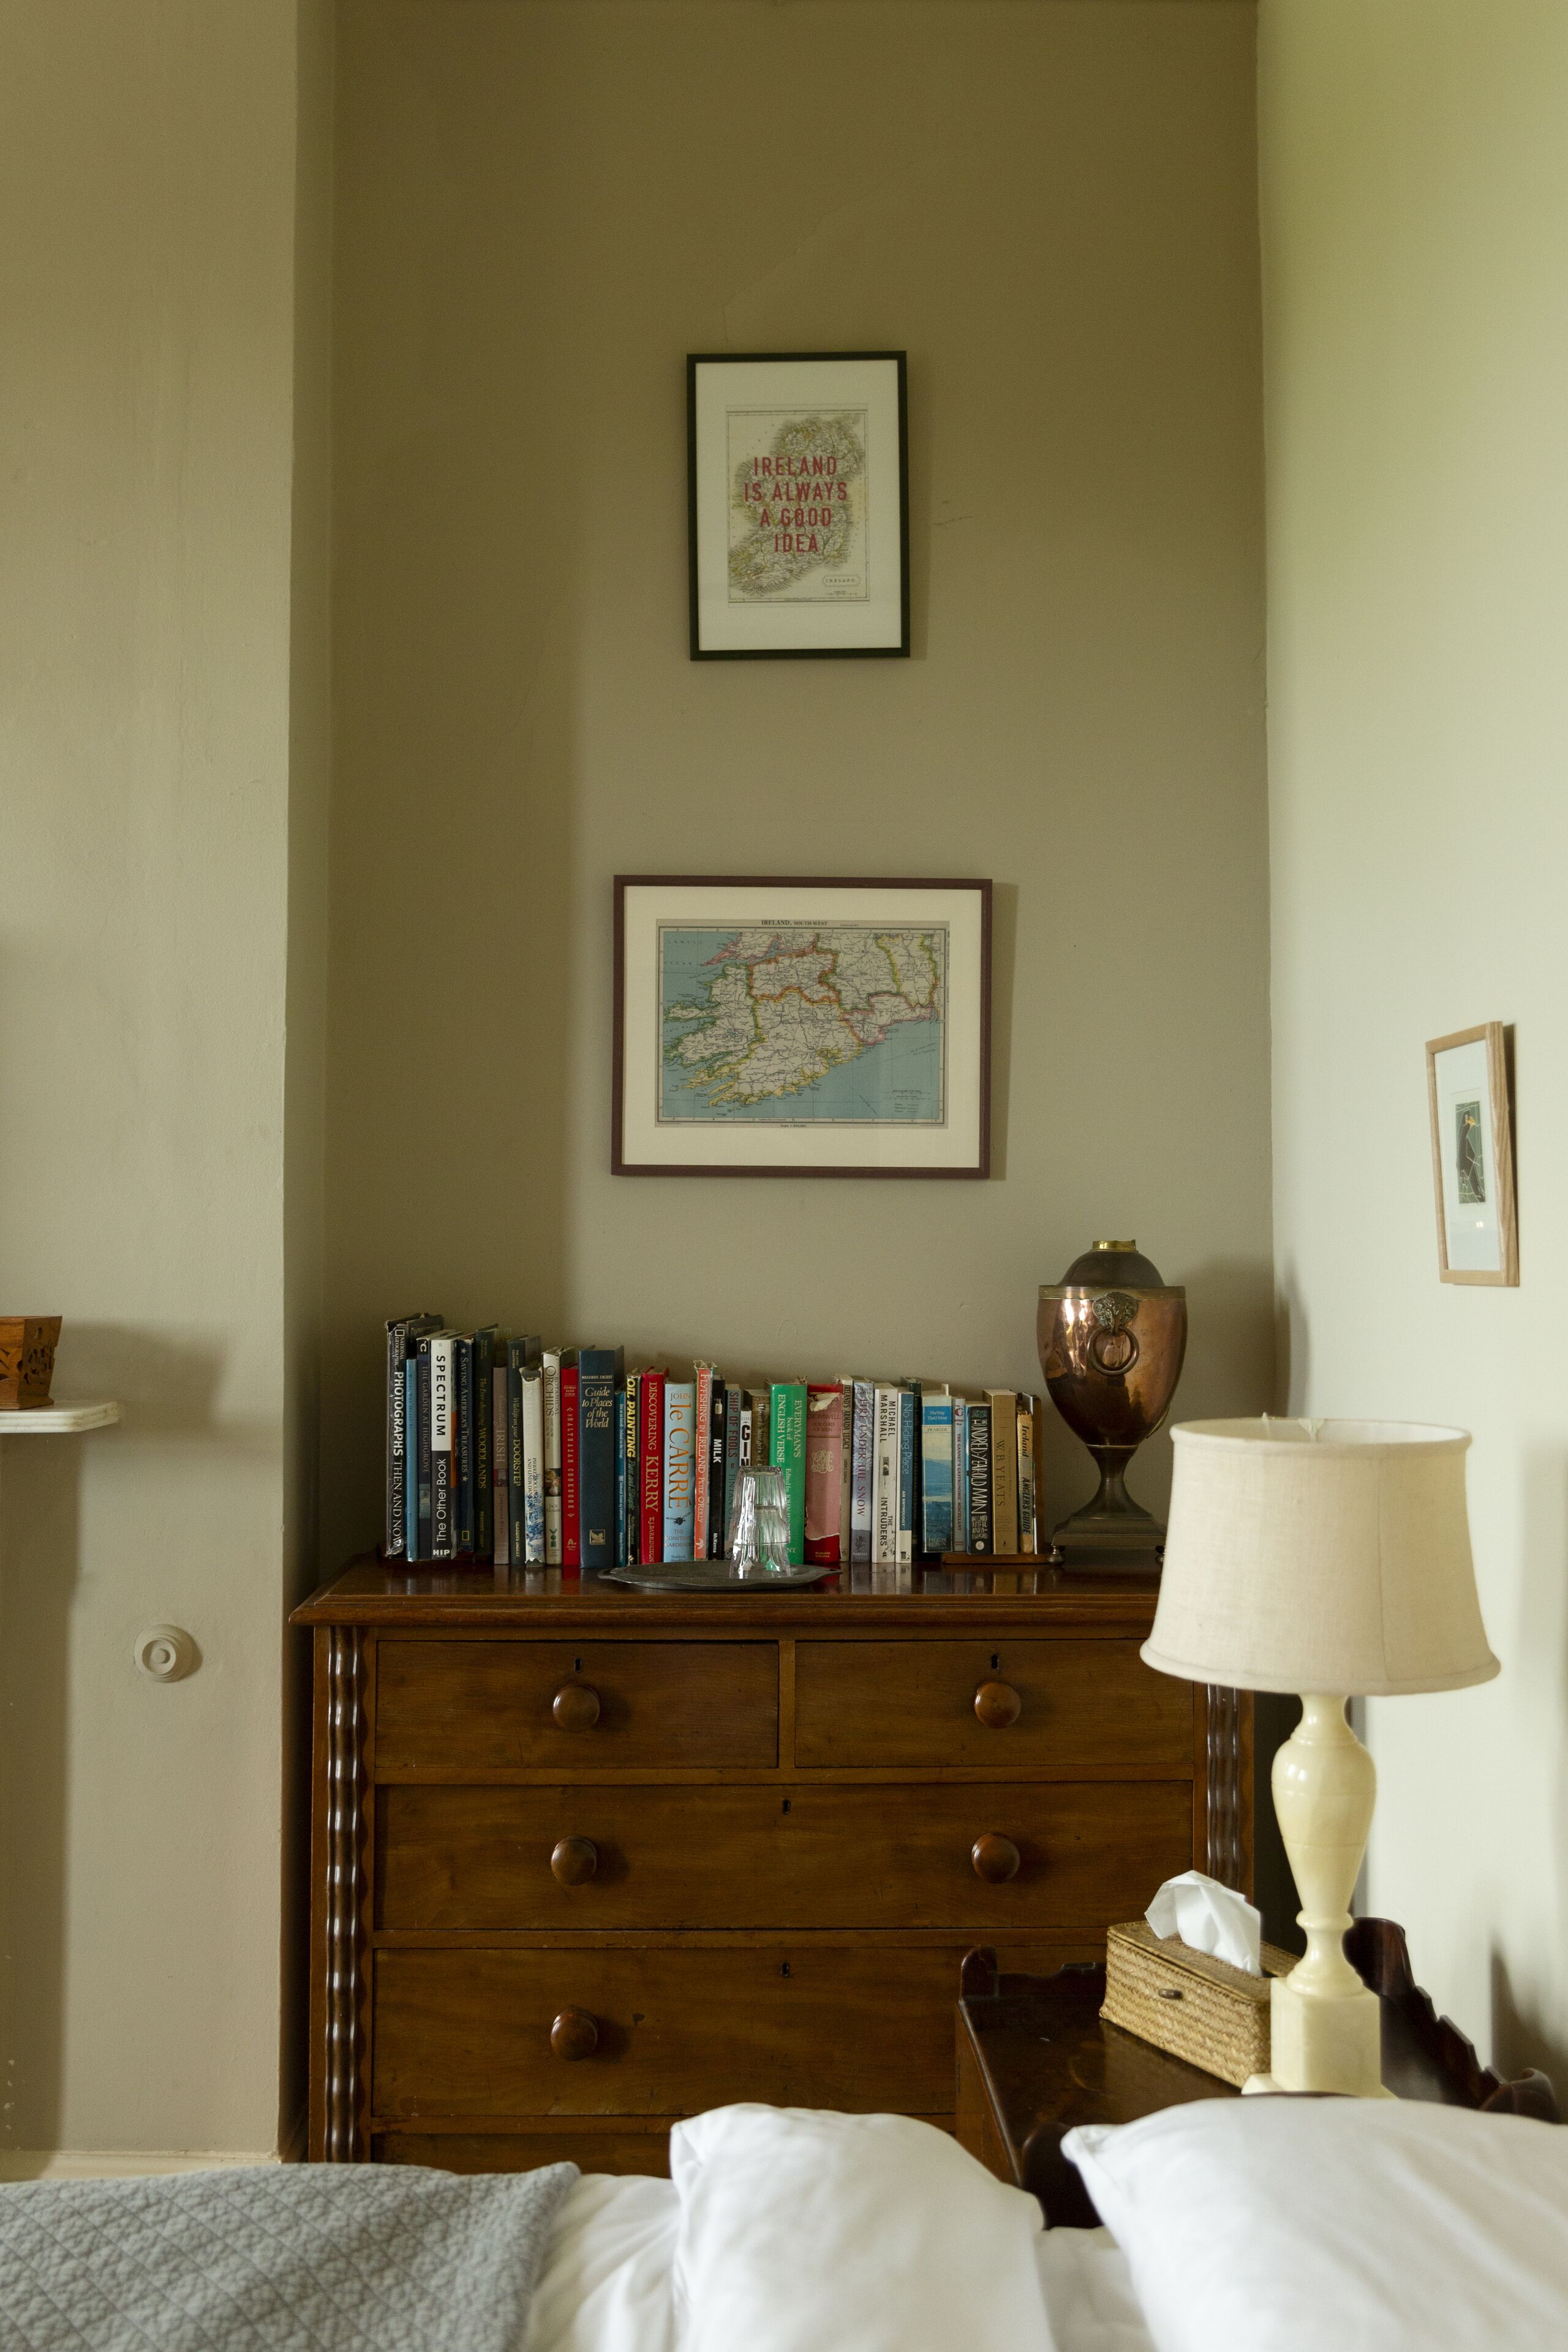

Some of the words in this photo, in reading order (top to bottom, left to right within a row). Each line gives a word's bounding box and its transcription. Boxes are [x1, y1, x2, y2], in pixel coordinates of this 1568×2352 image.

[753, 455, 838, 477] IRELAND
[744, 483, 763, 502] IS
[771, 481, 848, 502] ALWAYS
[759, 508, 771, 528] A
[780, 508, 832, 528] GOOD
[774, 533, 819, 553] IDEA
[460, 1357, 469, 1385] SAVING
[436, 1355, 446, 1436] SPECTRUM
[545, 1366, 556, 1416] ORCHIDS
[584, 1386, 610, 1397] Guide
[626, 1379, 636, 1398] OIL
[699, 1373, 710, 1422] FLYFISHING
[843, 1385, 852, 1408] IRELAND'S
[393, 1371, 404, 1457] PHOTOGRAPHS
[461, 1388, 470, 1428] AMERICA'S
[587, 1408, 597, 1419] of
[596, 1407, 608, 1417] the
[589, 1397, 613, 1408] Places
[669, 1403, 692, 1421] le
[728, 1392, 739, 1413] SHIP
[777, 1394, 786, 1433] ENGLISH
[859, 1399, 869, 1421] FIRE
[903, 1404, 913, 1418] No
[586, 1418, 609, 1428] World
[626, 1400, 636, 1458] PAINTING
[648, 1382, 658, 1450] DISCOVERING
[728, 1416, 739, 1427] OF
[794, 1400, 802, 1458] EVERYMAN'S
[496, 1430, 506, 1463] IRISH
[728, 1430, 739, 1458] FOOLS
[858, 1425, 868, 1459] UNDER
[901, 1420, 912, 1449] Hiding
[995, 1439, 1005, 1452] W.
[1022, 1425, 1030, 1458] Ireland
[461, 1428, 469, 1473] TREASURES
[478, 1428, 487, 1489] WOODLANDS
[698, 1436, 709, 1474] IRELAND
[712, 1439, 722, 1464] MILK
[777, 1434, 785, 1463] VERSE
[970, 1419, 989, 1487] HUNDRED-YEAR-OLD
[995, 1454, 1005, 1463] B.
[393, 1459, 403, 1490] THEN
[437, 1458, 447, 1485] Book
[513, 1439, 521, 1487] DOORSTEP
[627, 1460, 636, 1476] Pure
[668, 1428, 692, 1509] CARRÉ
[858, 1464, 866, 1481] THE
[902, 1452, 912, 1475] Place
[645, 1455, 659, 1512] KERRY
[697, 1477, 706, 1496] PETER
[996, 1465, 1006, 1507] YEATS
[393, 1493, 402, 1517] AND
[437, 1488, 447, 1520] Other
[627, 1488, 636, 1510] Simple
[857, 1486, 866, 1517] SNOW
[971, 1488, 988, 1514] MAN
[393, 1520, 402, 1545] NOW
[437, 1523, 447, 1542] The
[1022, 1510, 1031, 1535] GUIDE
